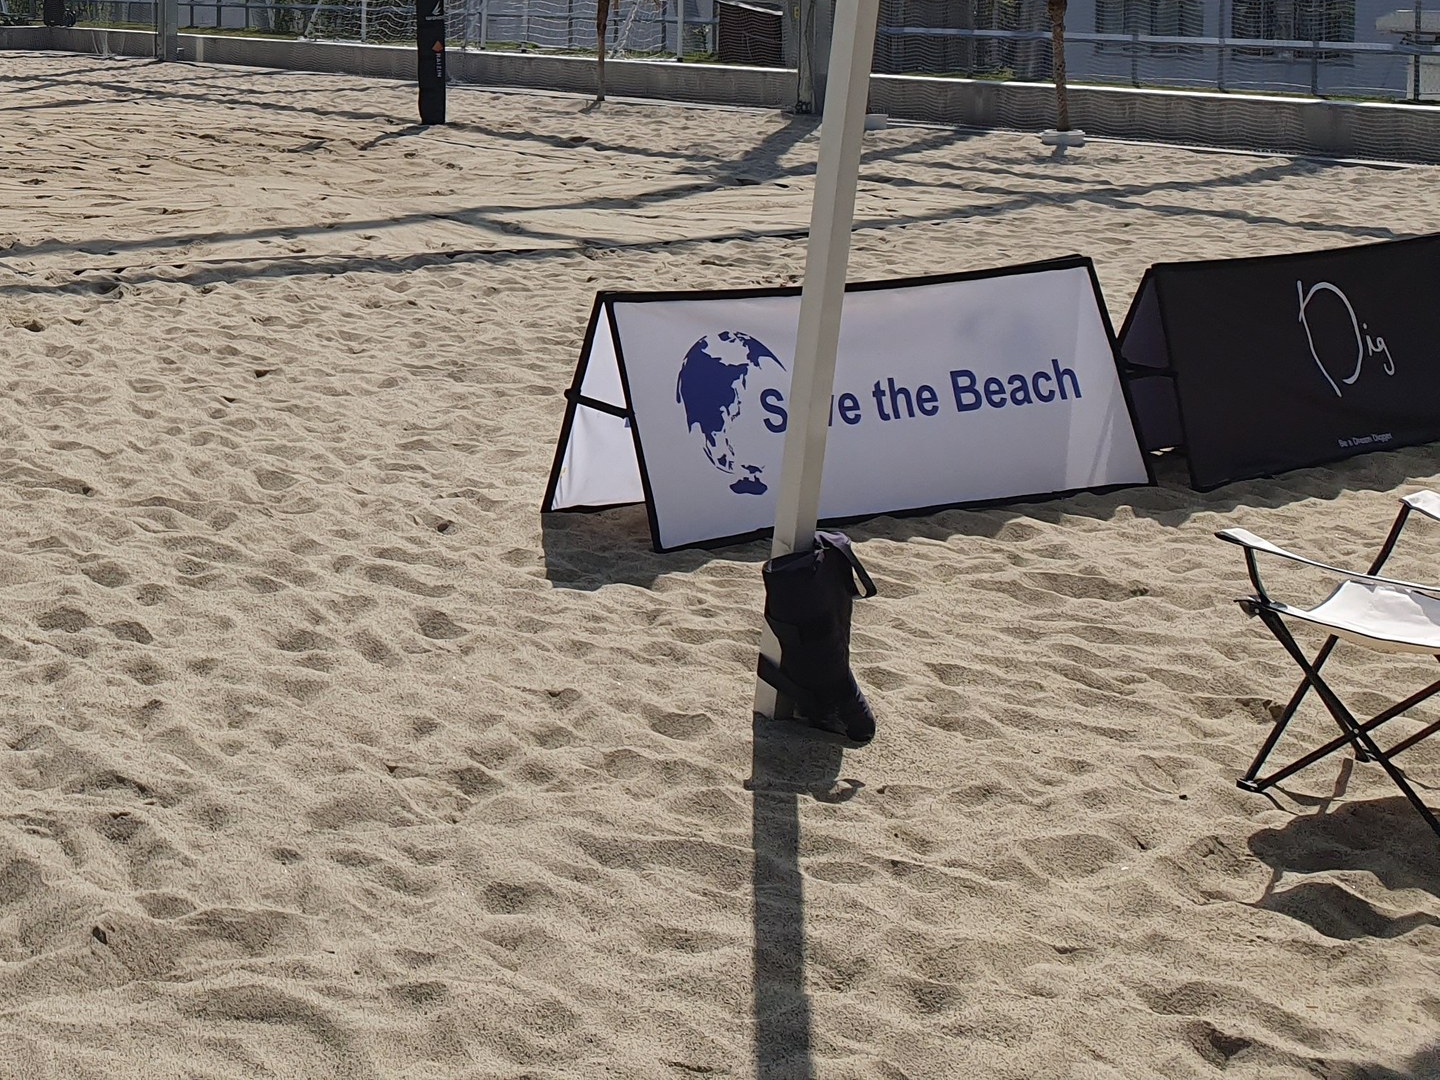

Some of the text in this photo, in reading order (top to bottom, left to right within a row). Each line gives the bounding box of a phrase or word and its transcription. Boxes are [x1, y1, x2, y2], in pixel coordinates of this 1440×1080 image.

[1296, 280, 1396, 397] Dig
[760, 358, 1083, 434] Se the Beach
